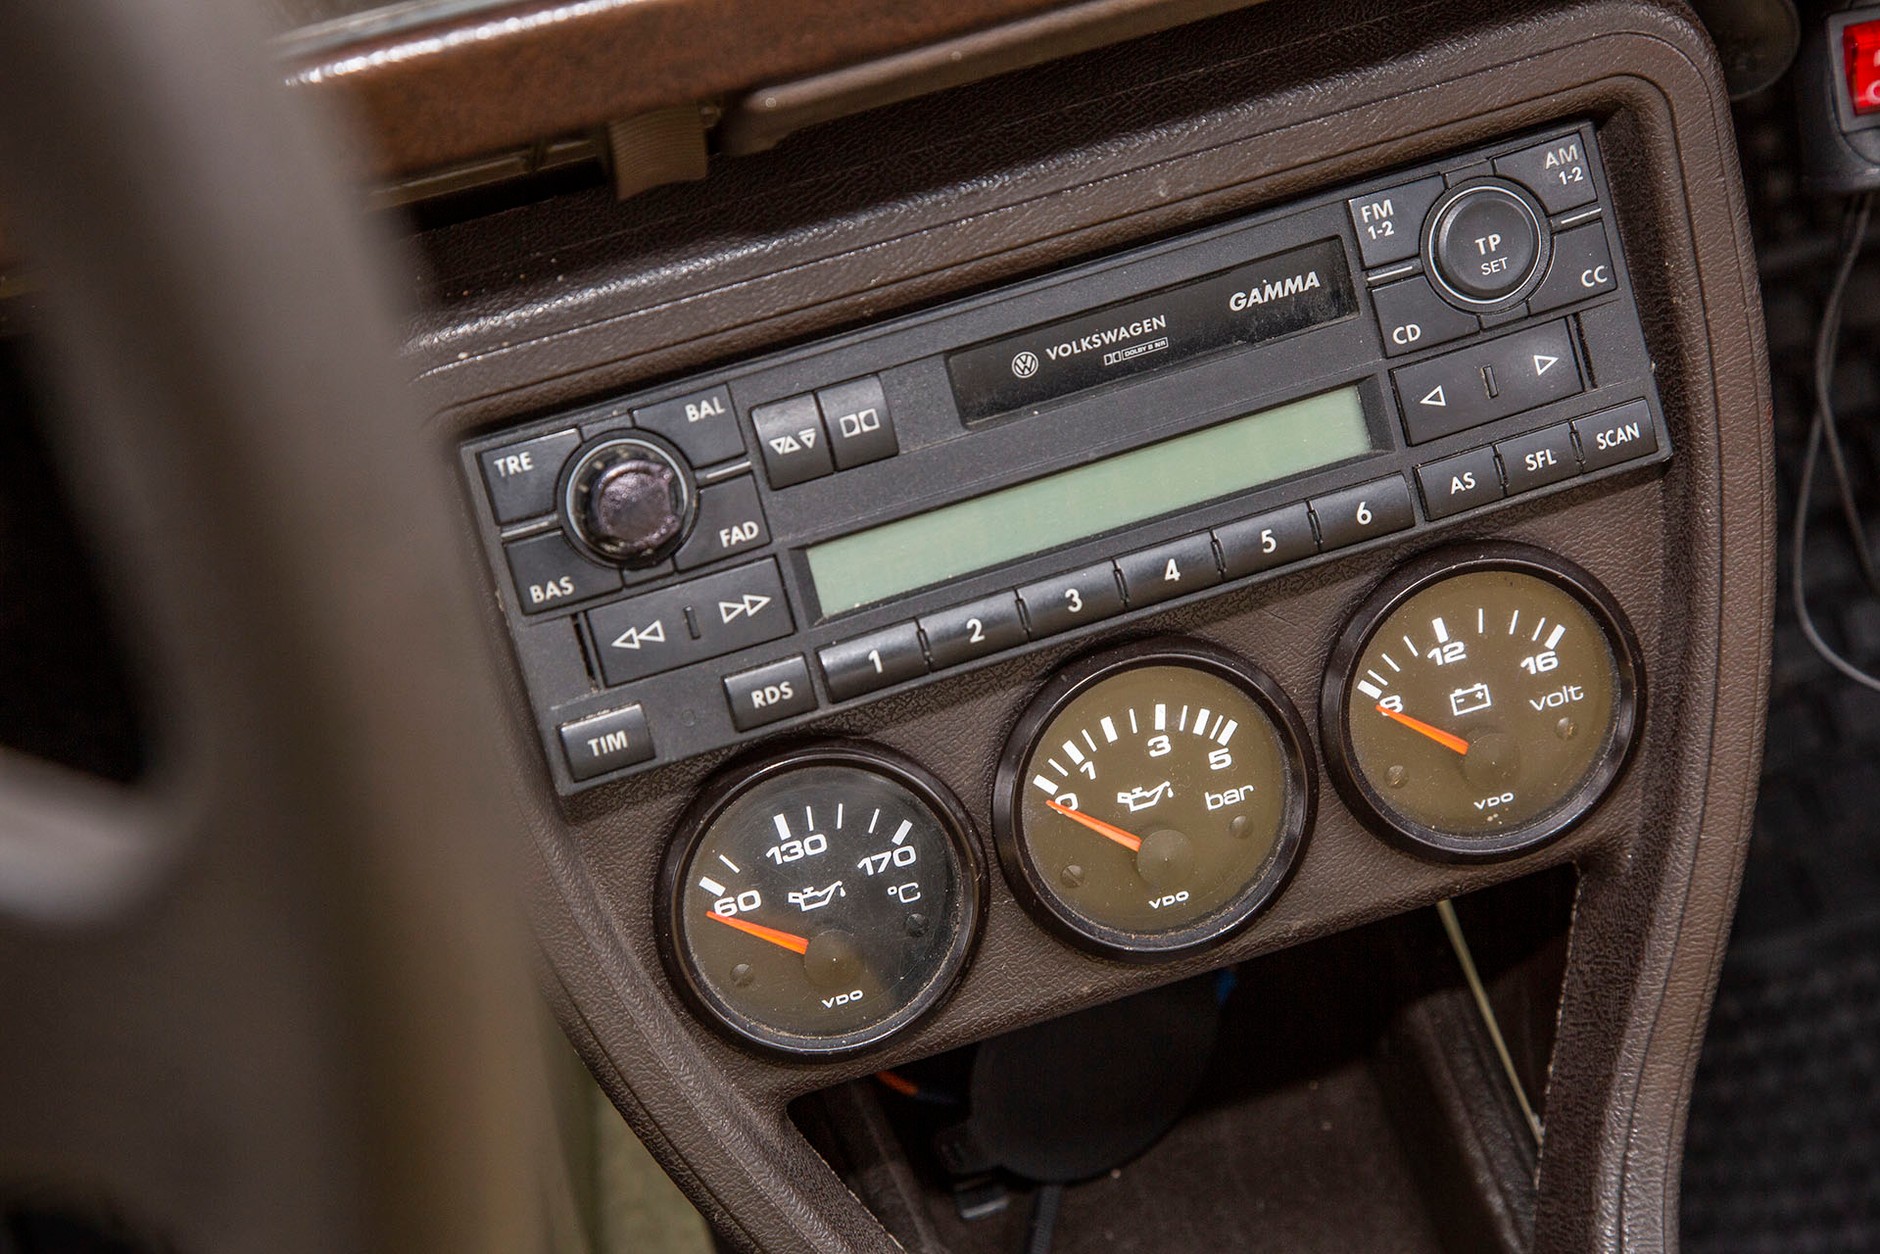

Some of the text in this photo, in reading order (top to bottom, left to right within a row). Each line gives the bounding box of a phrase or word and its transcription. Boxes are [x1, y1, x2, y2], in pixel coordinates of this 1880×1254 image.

[1545, 145, 1578, 169] AM
[1558, 167, 1583, 185] 1-2
[1361, 200, 1394, 223] FM
[1367, 222, 1394, 240] 1-2
[1475, 234, 1501, 255] TP
[1481, 257, 1508, 275] SET
[1581, 266, 1608, 288] CC
[1229, 271, 1321, 311] GAMMA
[1046, 314, 1167, 361] VOLKSWAGEN
[1393, 324, 1422, 344] CD
[1124, 346, 1147, 357] DOLBY
[685, 398, 725, 423] BAL
[1596, 422, 1640, 450] SCAN
[493, 452, 534, 478] TRE
[1525, 449, 1557, 472] SFL
[1450, 471, 1476, 494] AS
[1356, 502, 1373, 525] 6
[719, 521, 760, 548] FAD
[1261, 530, 1277, 554] 5
[1164, 559, 1181, 583] 4
[529, 576, 574, 603] BAS
[1065, 589, 1083, 613] 3
[966, 618, 985, 644] 2
[868, 650, 883, 673] 1
[1427, 641, 1467, 666] 12
[1520, 651, 1559, 674] 16
[750, 681, 794, 708] RDS
[1379, 694, 1404, 716] 8
[1529, 685, 1584, 711] volt
[587, 731, 628, 757] TIM
[1147, 734, 1172, 758] 3
[1080, 761, 1097, 780] 1
[1208, 747, 1232, 770] 5
[1054, 792, 1079, 814] 0
[1204, 784, 1254, 810] bar
[1473, 792, 1514, 810] VDO
[766, 833, 828, 865] 130
[857, 845, 917, 876] 170
[713, 890, 762, 918] 60
[1148, 890, 1190, 909] VDO
[821, 990, 864, 1009] VDO
